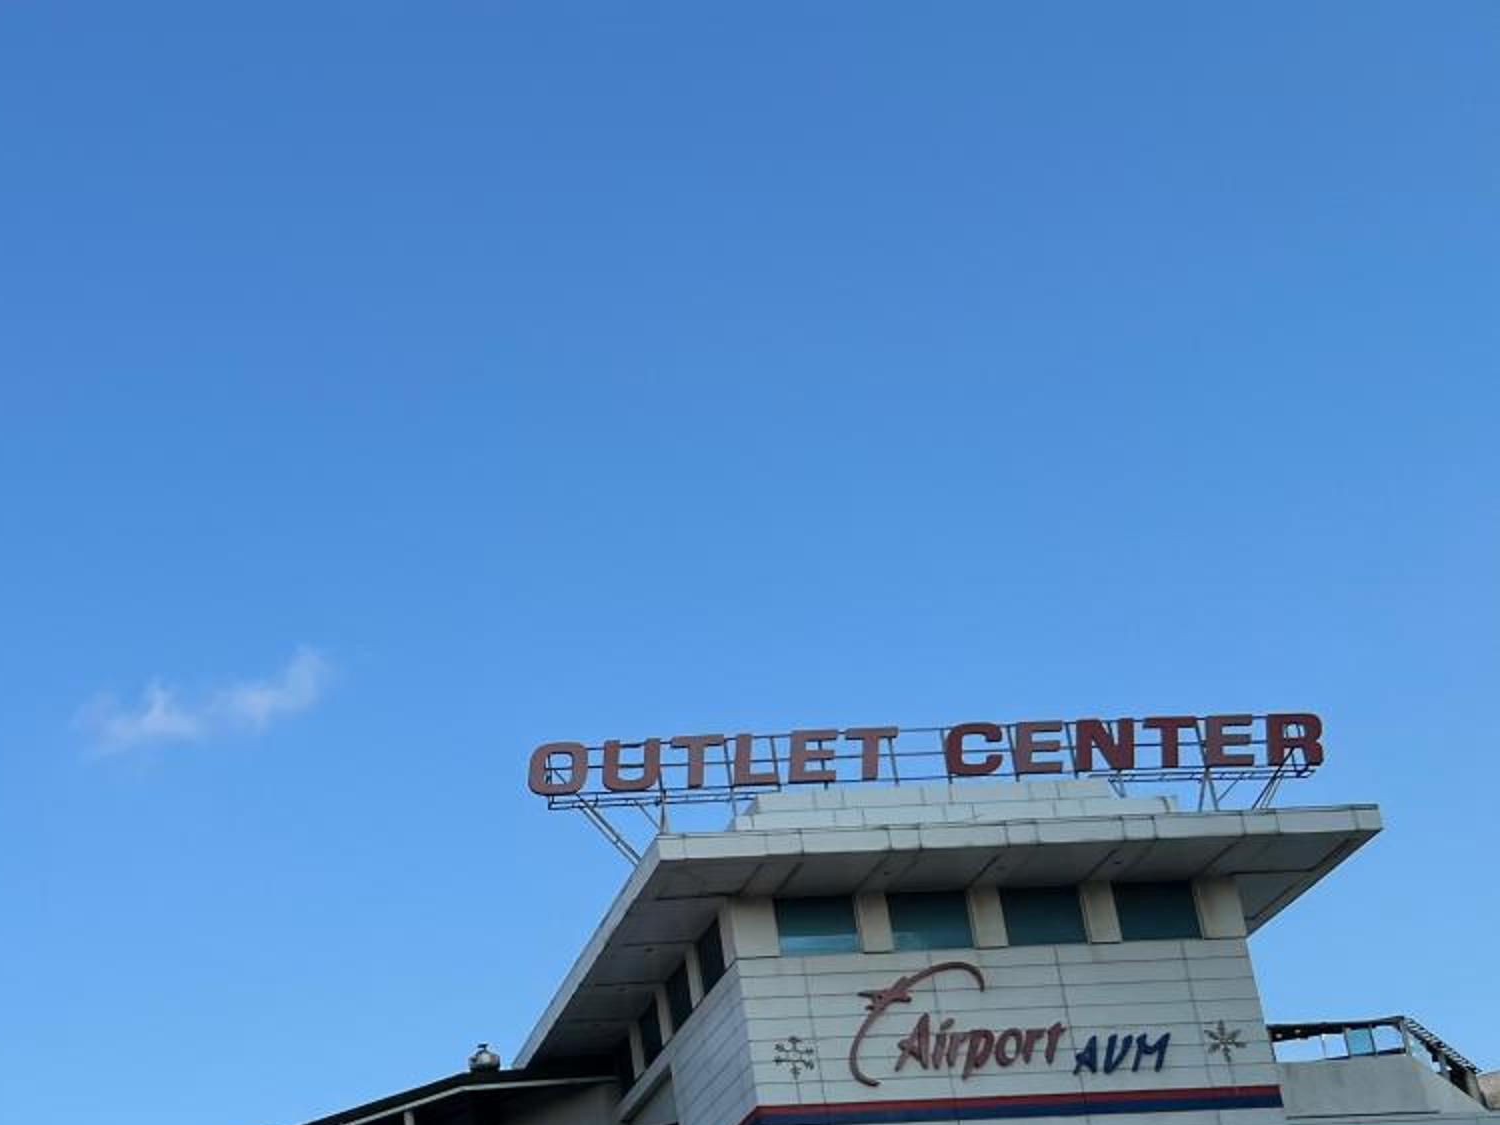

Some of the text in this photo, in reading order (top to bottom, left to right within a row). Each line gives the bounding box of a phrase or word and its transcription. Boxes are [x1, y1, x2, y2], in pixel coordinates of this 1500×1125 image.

[528, 712, 1323, 796] OUTLET CENTER
[895, 1012, 1170, 1080] Airport AVM
